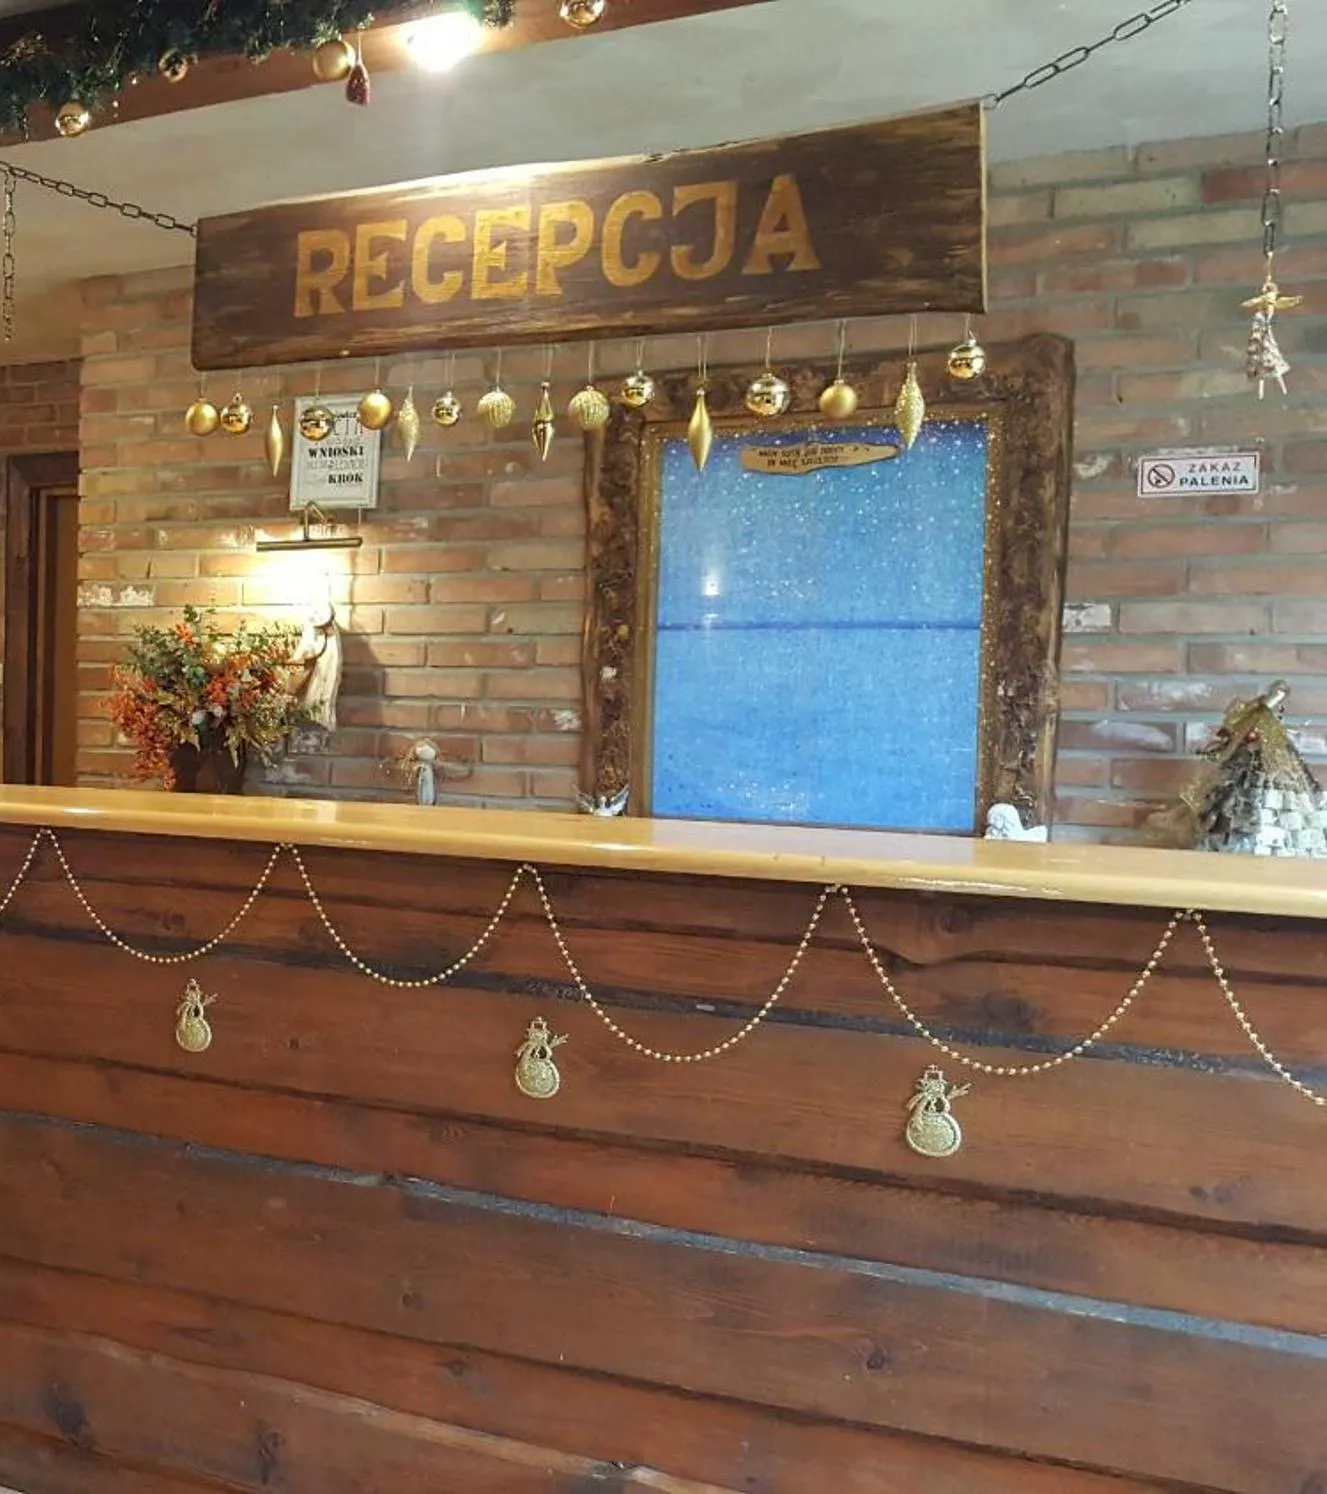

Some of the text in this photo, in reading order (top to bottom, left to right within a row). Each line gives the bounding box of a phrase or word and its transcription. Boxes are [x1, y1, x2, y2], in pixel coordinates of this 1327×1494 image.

[293, 174, 821, 318] RECEPCJA
[308, 446, 363, 458] WNIOSKI
[1188, 461, 1241, 473] ZAKAZ
[1179, 475, 1249, 487] PALENIA
